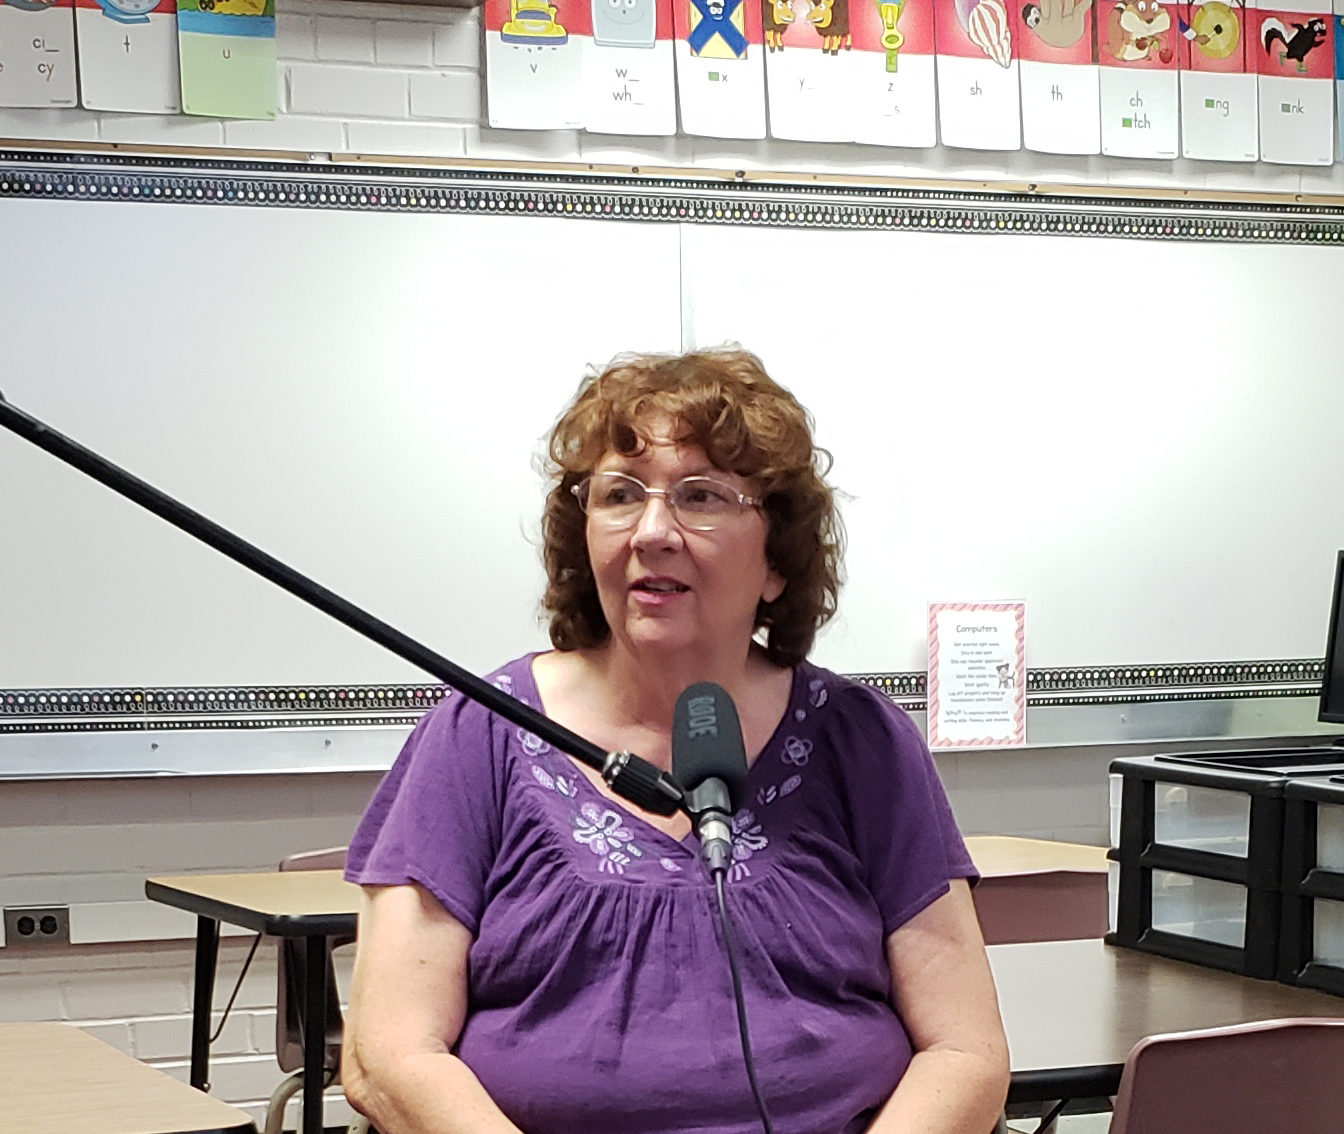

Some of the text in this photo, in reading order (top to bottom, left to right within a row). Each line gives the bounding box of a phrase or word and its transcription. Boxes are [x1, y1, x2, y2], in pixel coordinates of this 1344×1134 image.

[123, 35, 131, 53] t
[222, 49, 231, 60] u
[37, 63, 55, 82] cy
[530, 63, 538, 74] v
[969, 80, 983, 96] sh
[1050, 83, 1064, 102] th
[1129, 91, 1143, 108] ch
[1214, 98, 1231, 118] ng
[1291, 99, 1305, 116] nk
[1133, 113, 1152, 131] tch
[956, 624, 998, 634] Computers
